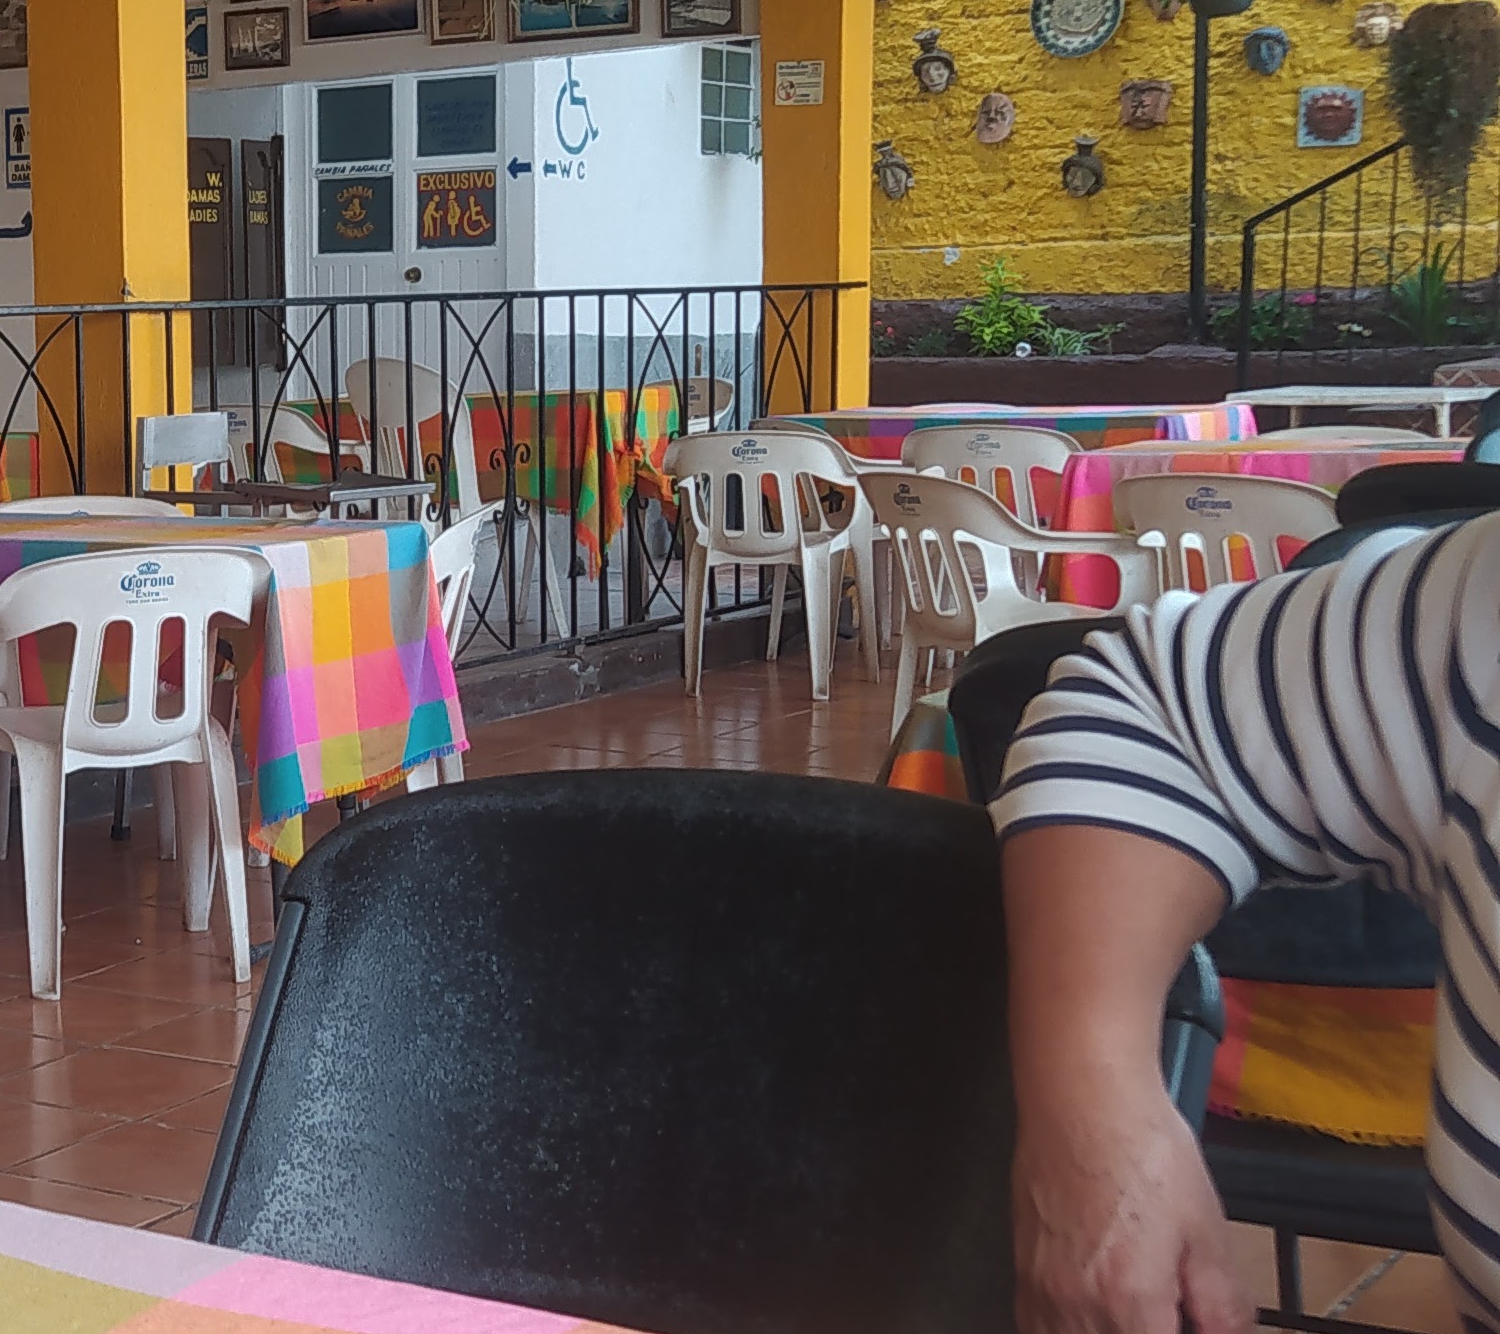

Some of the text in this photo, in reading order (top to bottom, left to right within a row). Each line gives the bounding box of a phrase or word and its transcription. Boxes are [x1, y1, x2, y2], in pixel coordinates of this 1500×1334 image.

[14, 161, 31, 172] BAÑ
[558, 160, 586, 180] WC
[11, 173, 30, 182] DAM
[420, 171, 495, 191] EXCLUSIVO
[336, 186, 373, 202] CAMBIA
[190, 209, 218, 223] ADIES
[120, 574, 175, 592] Corona
[135, 589, 160, 598] Extra
